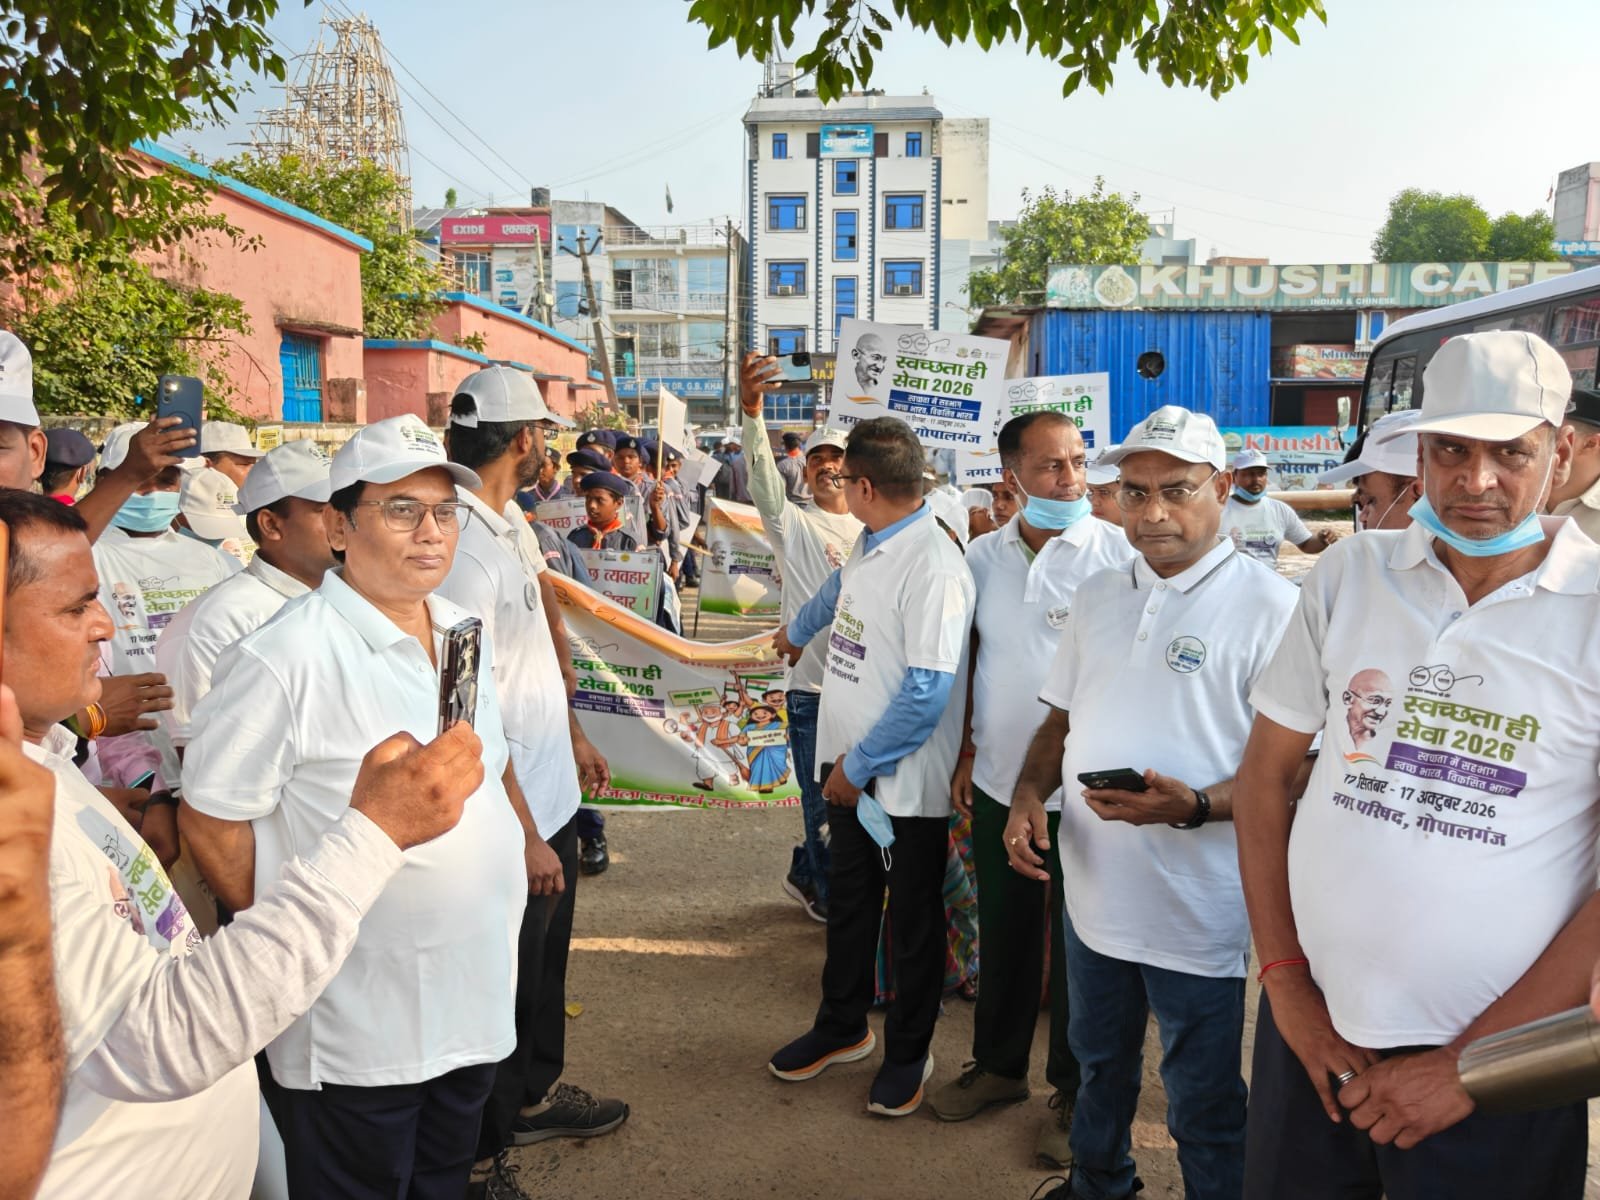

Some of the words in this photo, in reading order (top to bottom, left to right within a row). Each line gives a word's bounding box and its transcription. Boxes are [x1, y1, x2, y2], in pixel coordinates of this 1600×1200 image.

[452, 224, 485, 235] EXIDE
[1140, 264, 1389, 298] KHUSHI
[1310, 297, 1344, 306] INDIAN
[896, 355, 964, 377] स्वच्छता
[966, 361, 988, 379] ही
[892, 370, 929, 390] सेवा
[932, 378, 974, 396] 2026
[1073, 396, 1093, 412] ही
[838, 413, 863, 427] नग
[641, 664, 663, 680] ही
[577, 675, 617, 693] सेवा
[622, 681, 654, 697] 2026
[1402, 695, 1504, 732] स्वच्छता
[1504, 713, 1542, 744] ही
[1395, 716, 1449, 746] सेवा
[1451, 729, 1517, 764] 2026
[1393, 761, 1417, 774] स्वच्छ
[1447, 771, 1487, 790] विकसित
[1449, 756, 1459, 768] में
[1461, 760, 1499, 778] सहभाग
[1357, 772, 1388, 794] सितंबर
[1400, 786, 1416, 801] 17
[1462, 800, 1497, 819] 2026
[1357, 799, 1410, 830] परिषद,
[1416, 813, 1507, 847] गोपालगंज
